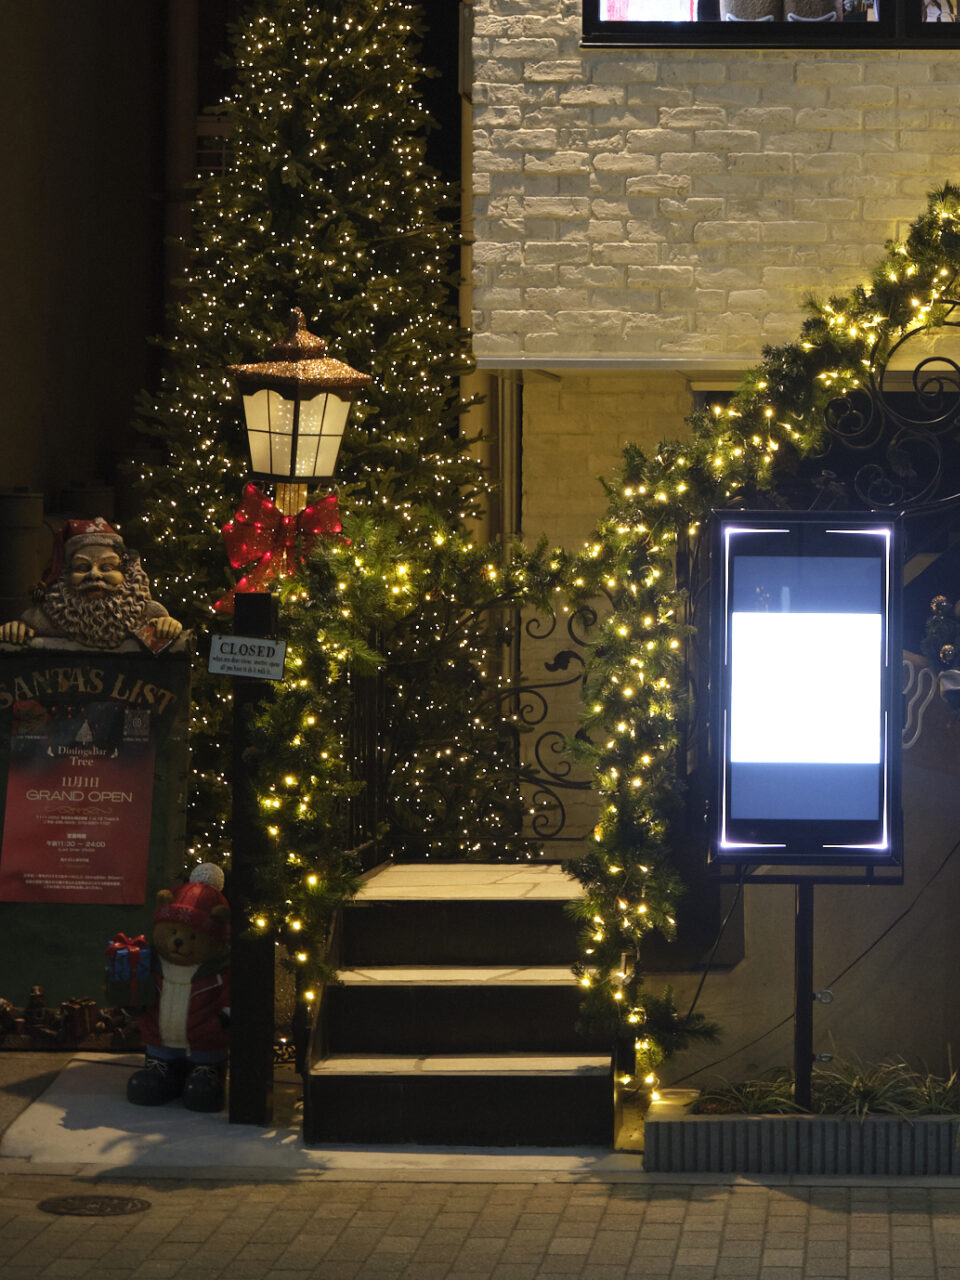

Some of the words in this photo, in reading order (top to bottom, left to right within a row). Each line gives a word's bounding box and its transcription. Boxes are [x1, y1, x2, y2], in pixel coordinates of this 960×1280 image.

[220, 642, 276, 658] CLOSED
[110, 674, 177, 715] LIST
[70, 756, 94, 767] Tree
[26, 790, 84, 801] GRAND
[88, 791, 133, 803] OPEN
